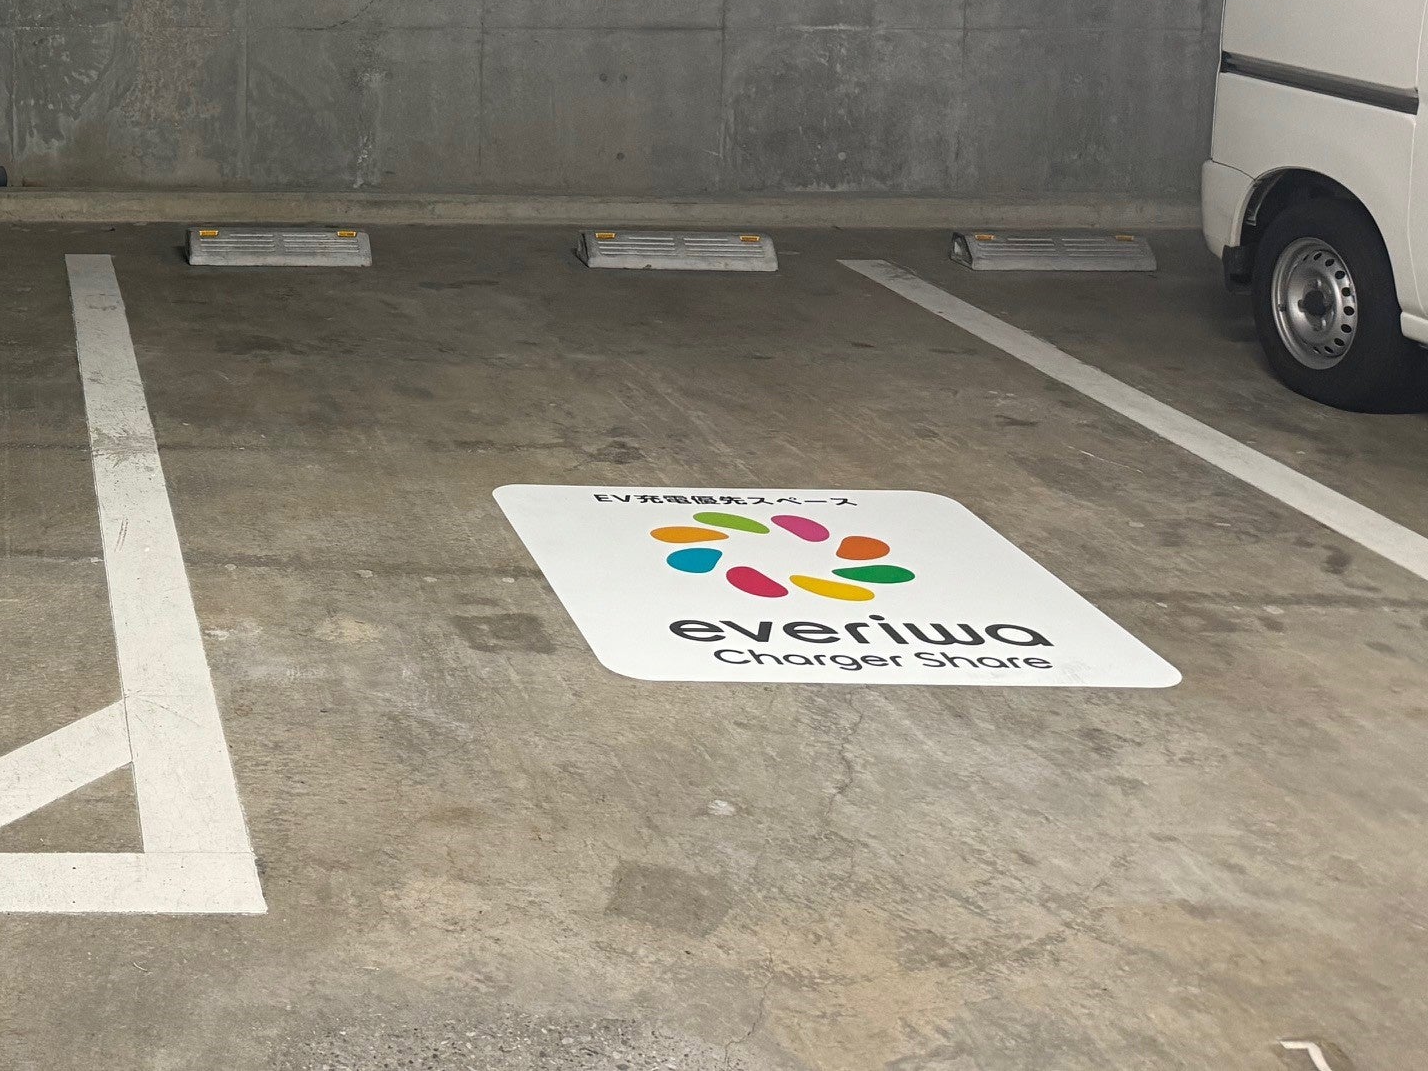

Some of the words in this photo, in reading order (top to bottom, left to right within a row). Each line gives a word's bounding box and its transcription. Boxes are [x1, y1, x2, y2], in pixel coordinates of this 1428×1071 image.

[593, 493, 859, 507] EV充電優先スペース
[668, 614, 1055, 647] everiwa
[713, 648, 904, 671] Charger
[913, 650, 1054, 670] Share
